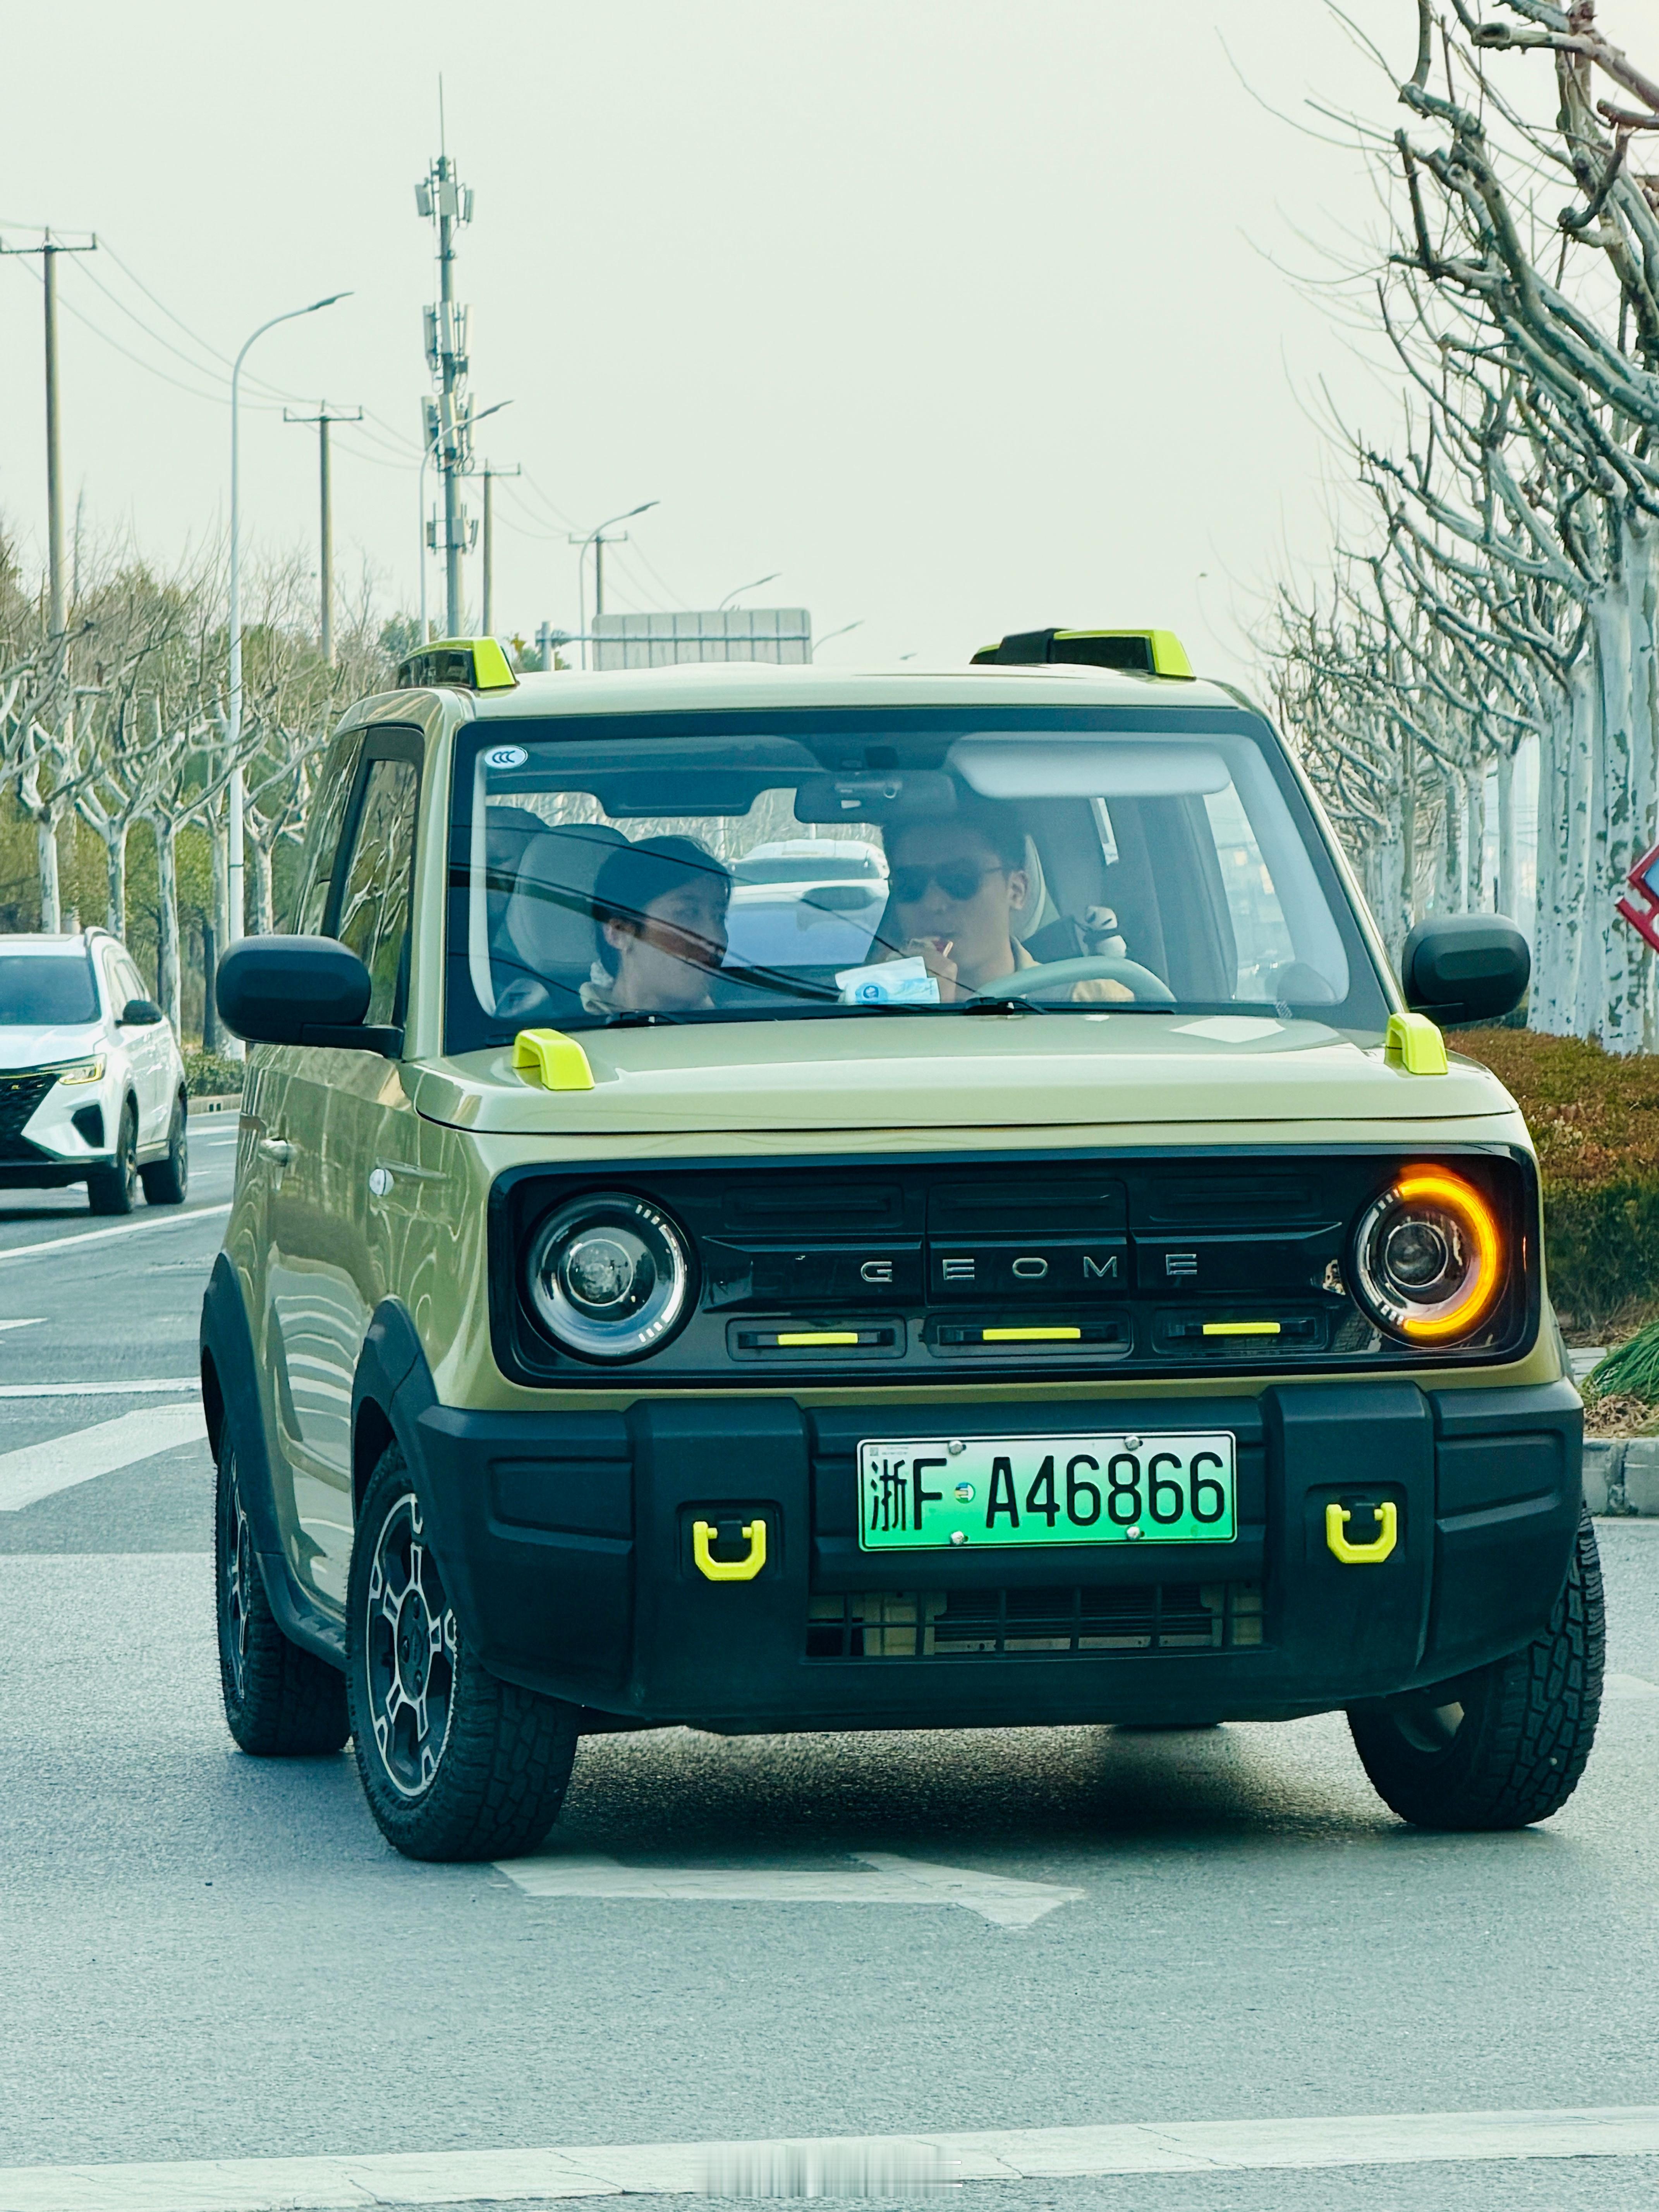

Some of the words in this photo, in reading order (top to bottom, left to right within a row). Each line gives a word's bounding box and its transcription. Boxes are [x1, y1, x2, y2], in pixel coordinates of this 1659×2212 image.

[492, 750, 515, 763] CCC
[861, 1254, 1197, 1282] GEOME
[986, 1452, 1224, 1528] A46866
